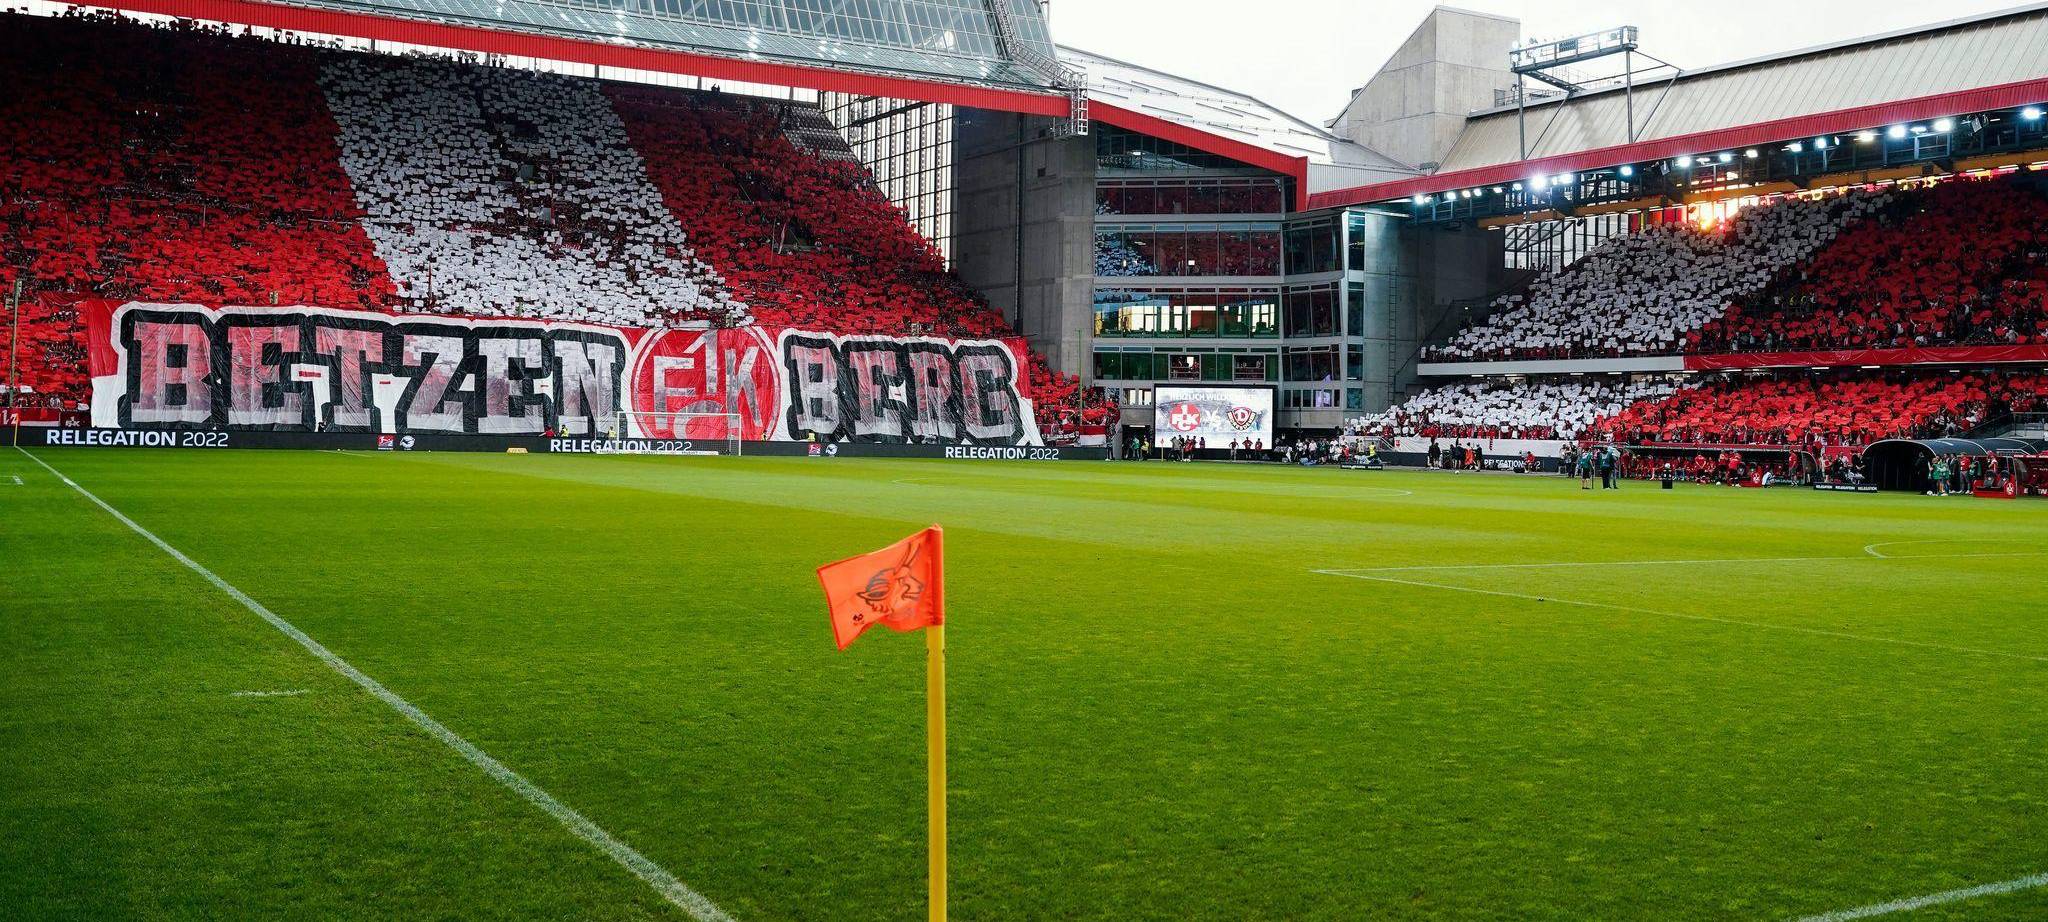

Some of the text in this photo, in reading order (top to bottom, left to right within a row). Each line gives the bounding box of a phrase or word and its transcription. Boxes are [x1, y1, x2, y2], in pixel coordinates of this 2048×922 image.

[130, 320, 617, 434] BETZEN
[789, 344, 1009, 438] BERG
[46, 429, 229, 447] RELEGATION 2022
[550, 439, 693, 452] RELEGATION 2022
[945, 446, 1059, 460] RELEGATION 2022
